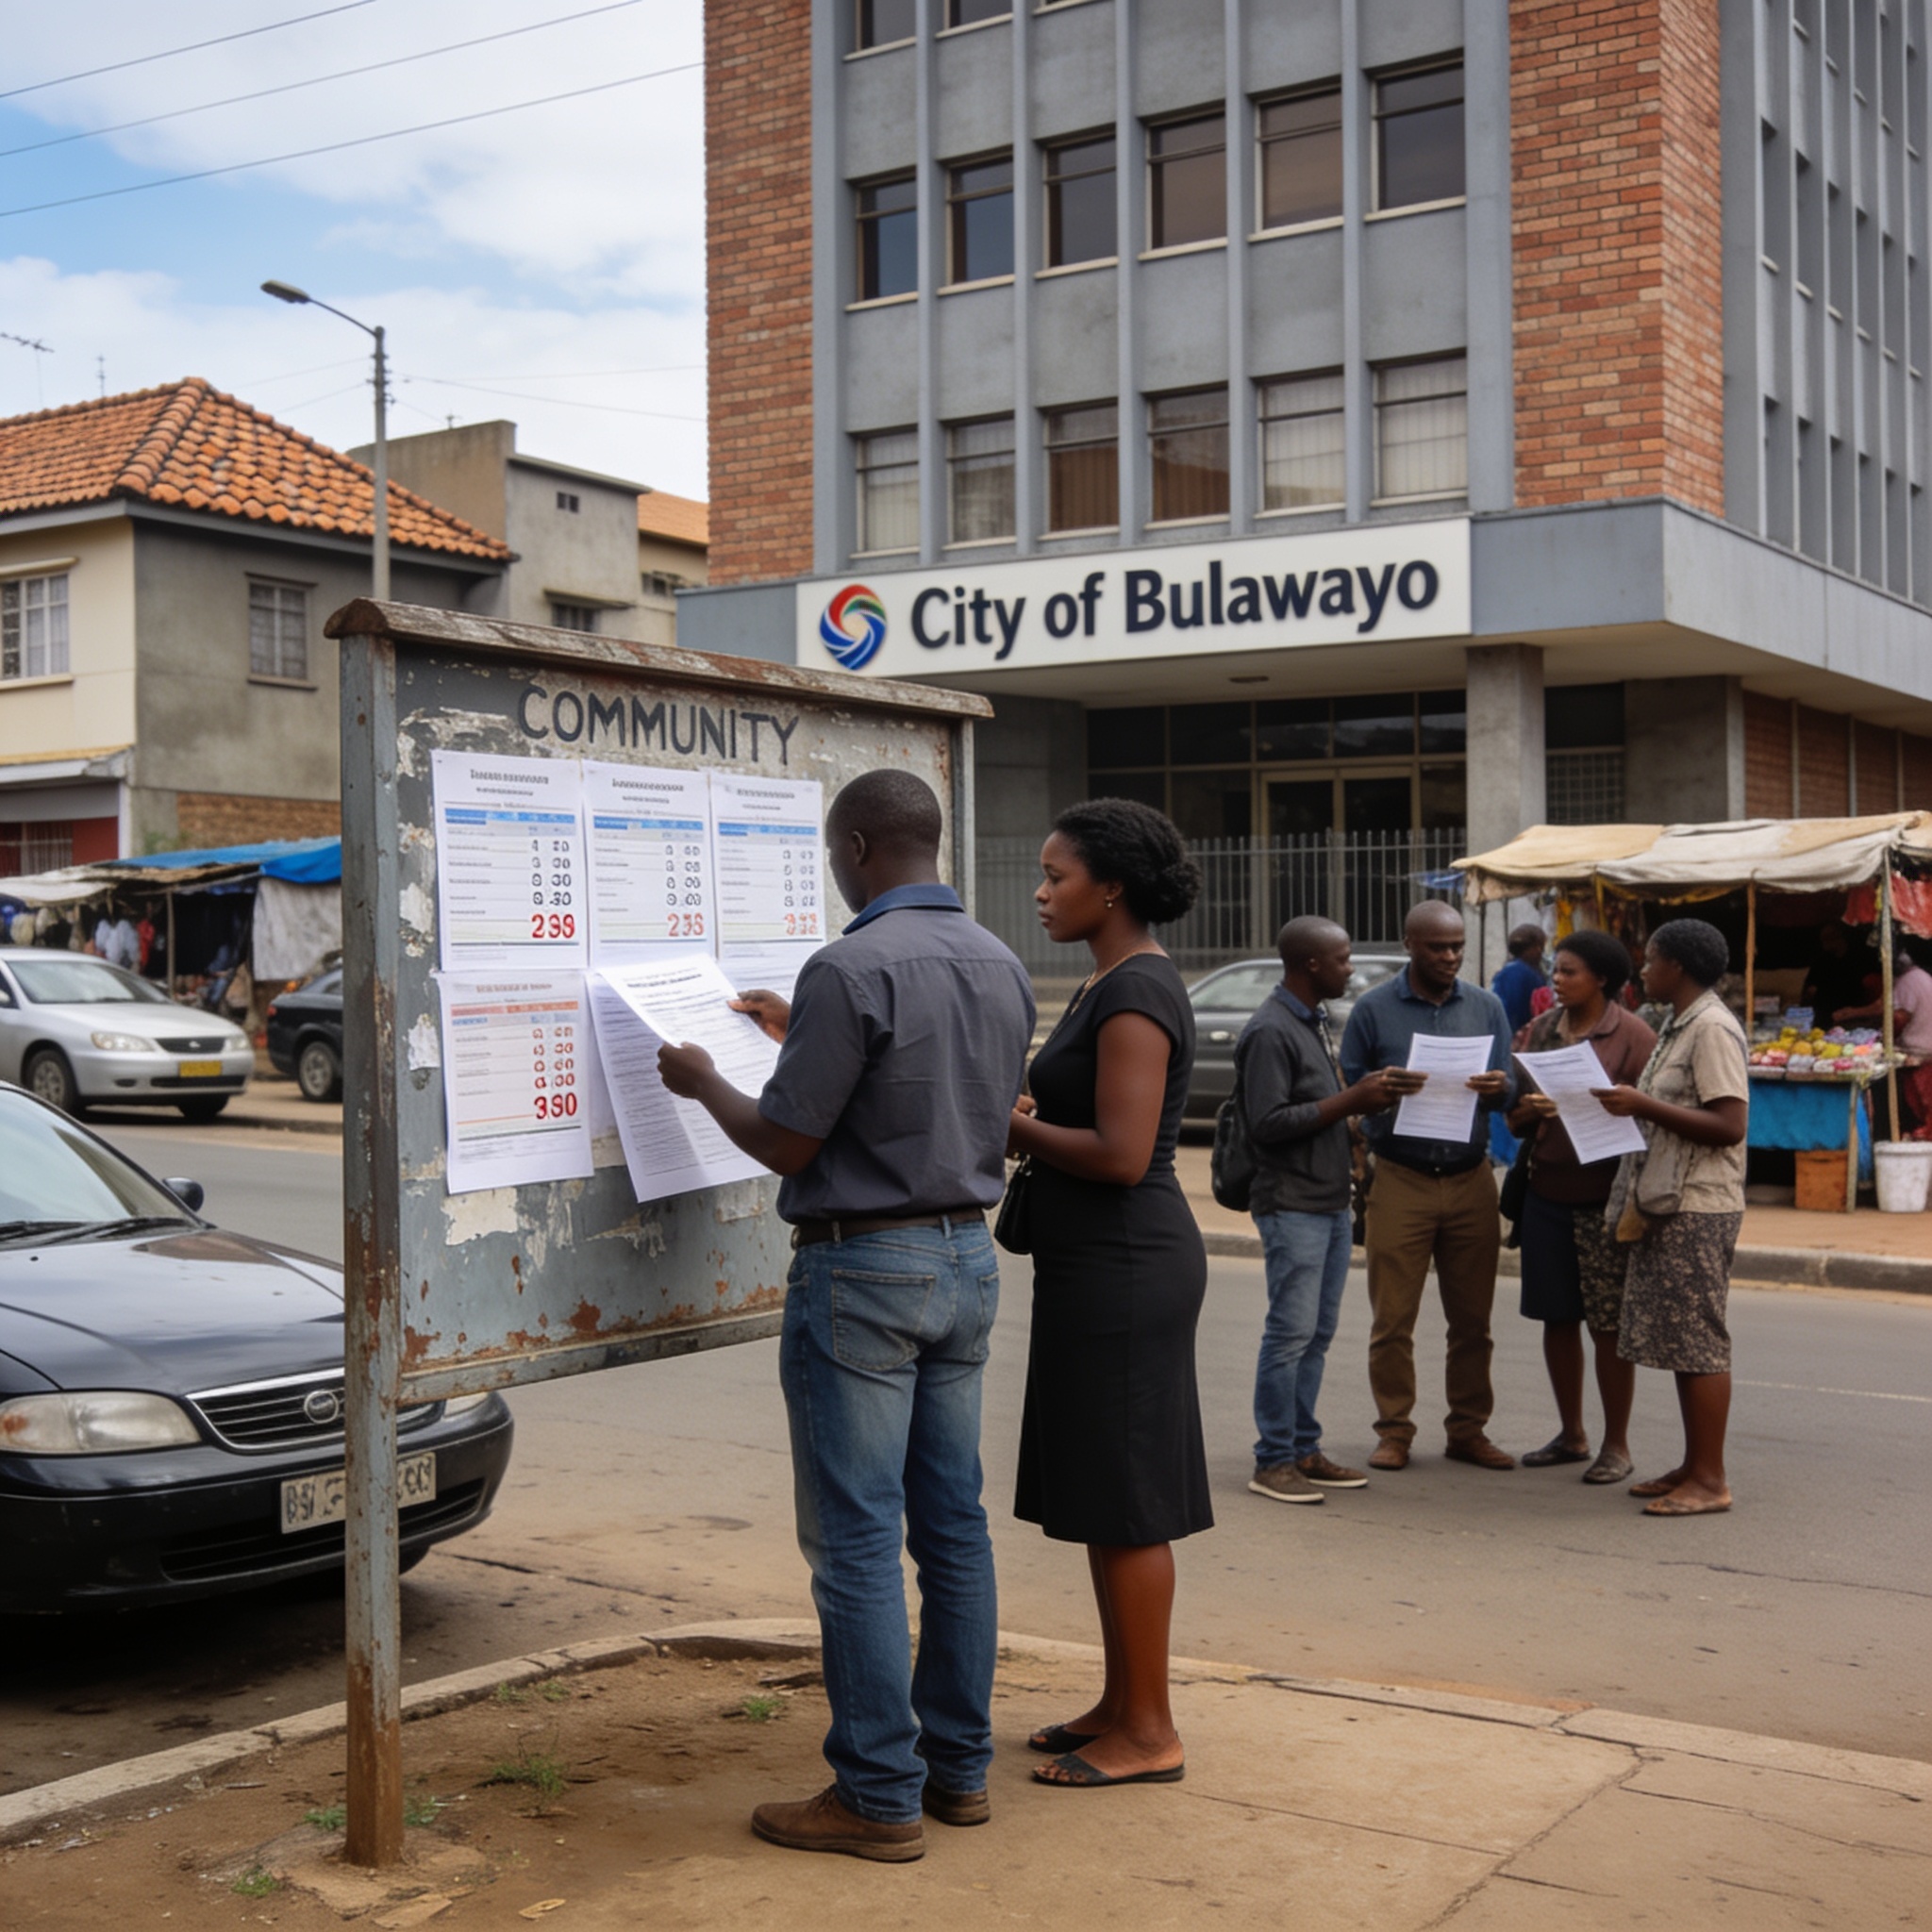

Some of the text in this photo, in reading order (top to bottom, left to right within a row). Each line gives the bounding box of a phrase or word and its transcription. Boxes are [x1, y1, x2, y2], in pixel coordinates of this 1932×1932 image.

[911, 559, 1440, 659] City of Bulawayo
[518, 685, 799, 765] COMMUNITY
